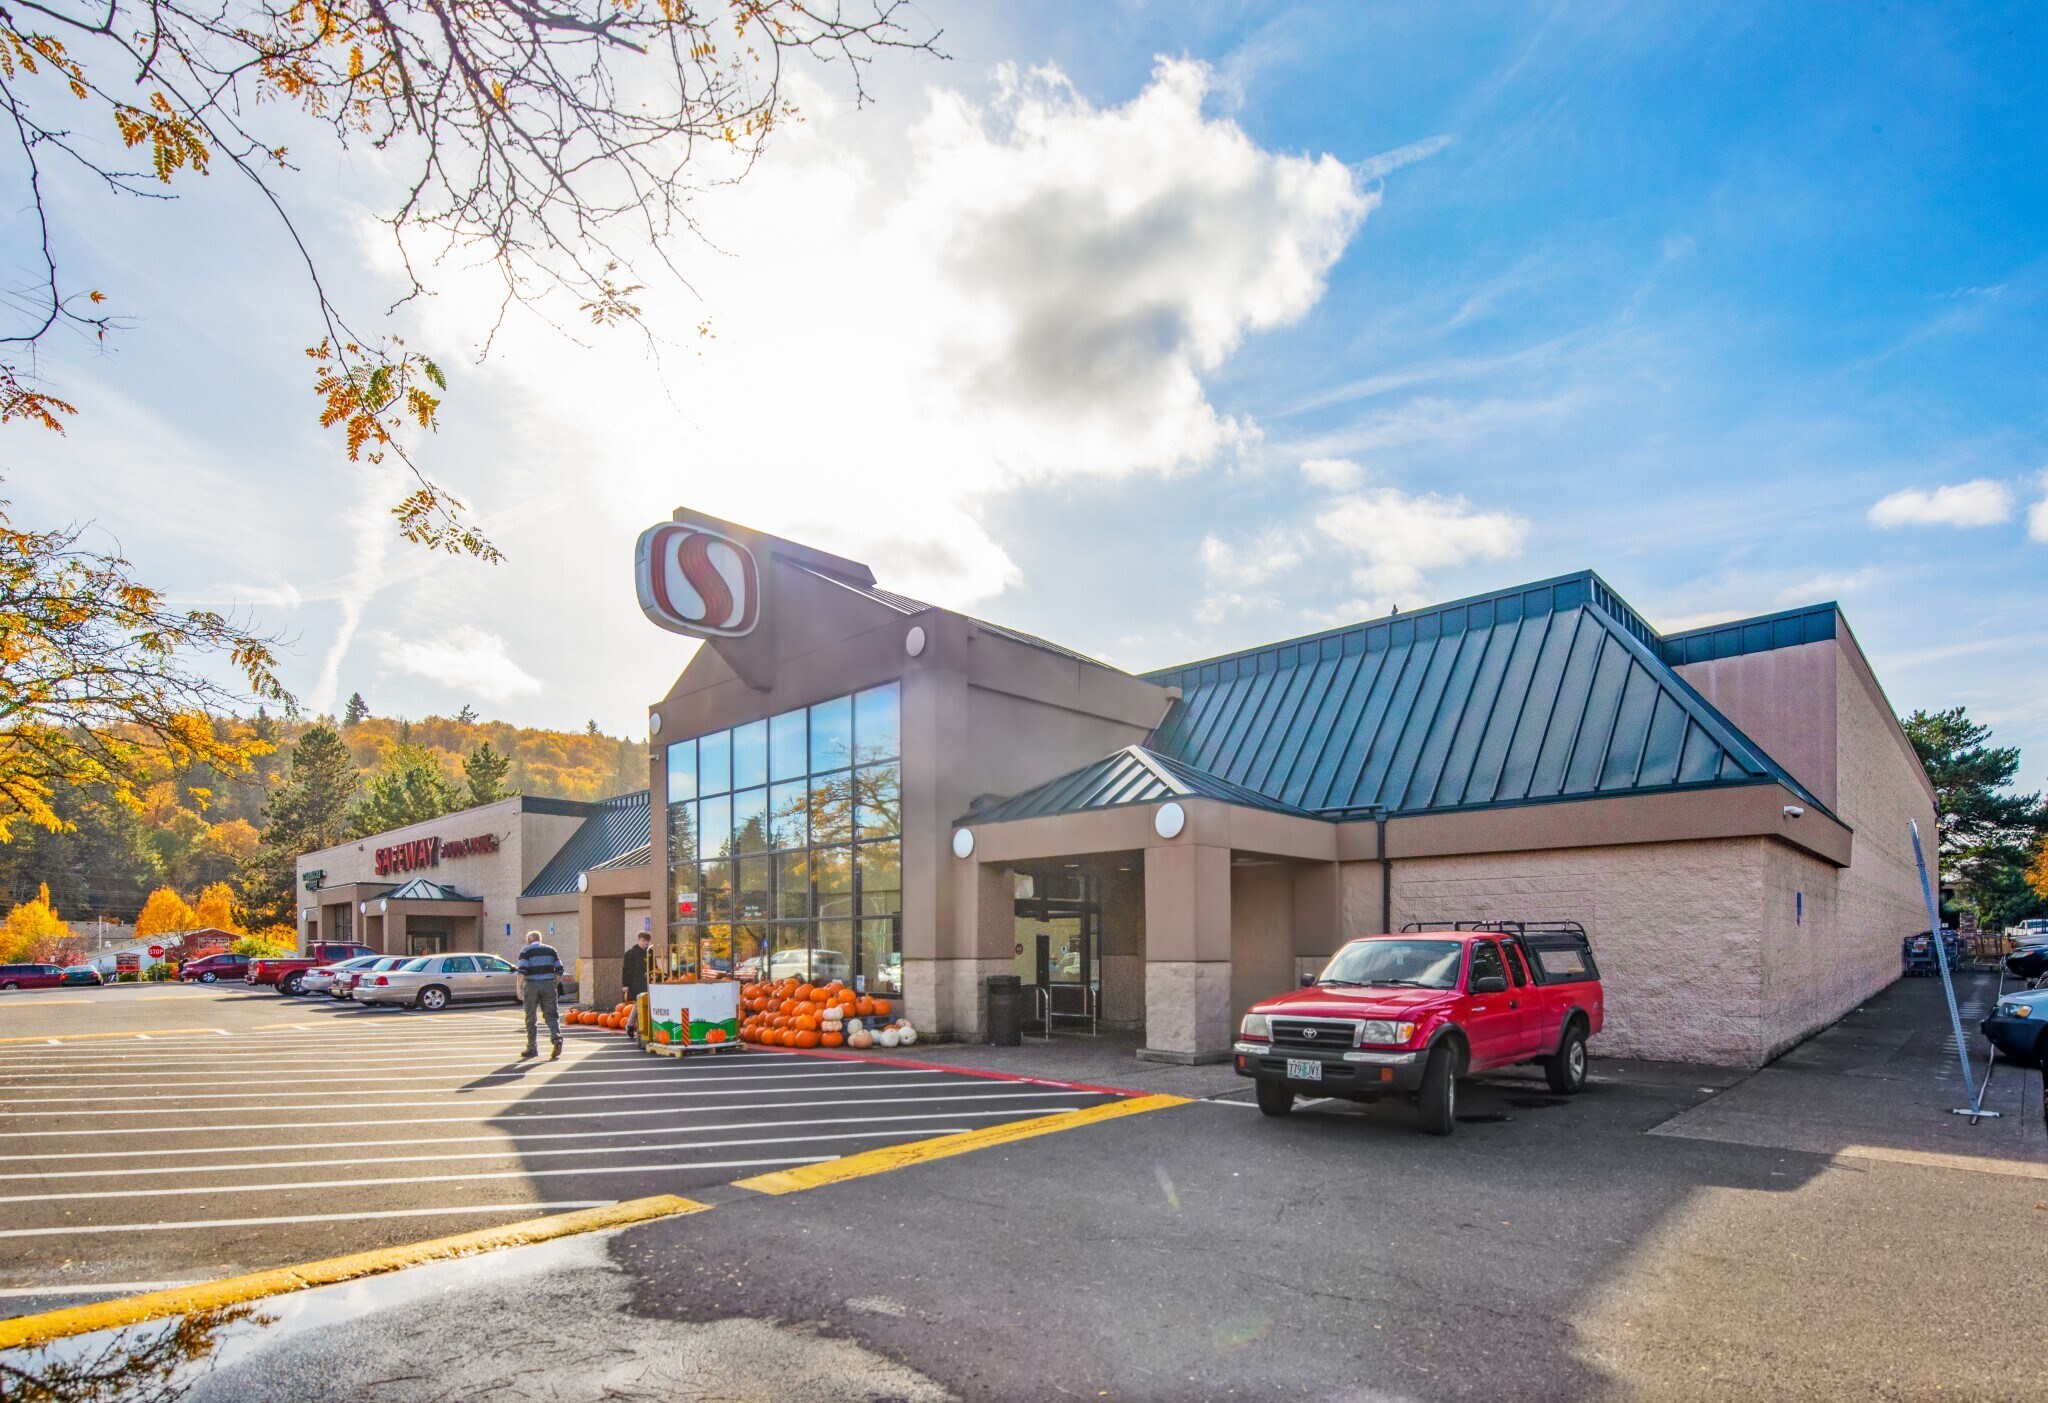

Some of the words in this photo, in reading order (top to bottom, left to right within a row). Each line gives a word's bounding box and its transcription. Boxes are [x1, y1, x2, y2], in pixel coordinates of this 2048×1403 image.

[375, 836, 438, 875] SAFEWAY
[1289, 1063, 1302, 1074] 779
[1307, 1065, 1320, 1076] JVY
